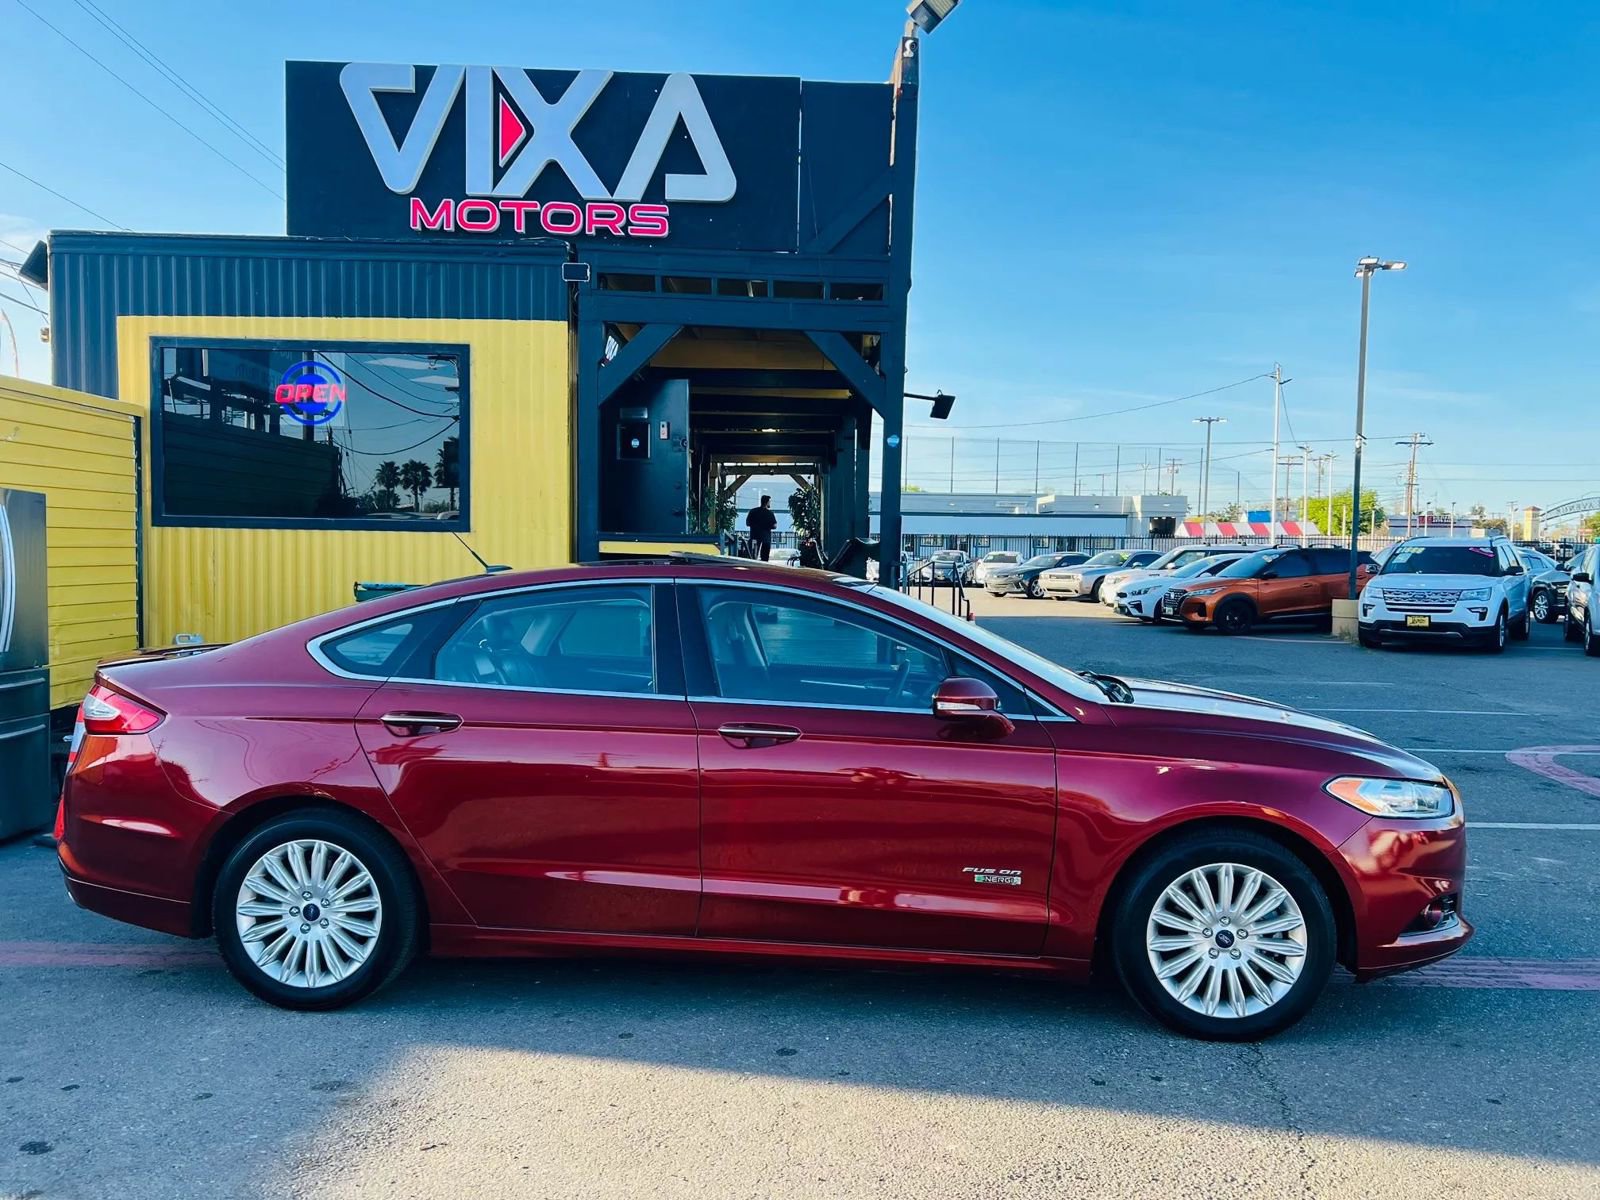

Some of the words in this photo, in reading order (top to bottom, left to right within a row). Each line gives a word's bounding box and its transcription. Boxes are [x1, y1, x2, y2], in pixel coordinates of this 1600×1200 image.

[340, 62, 737, 202] VIXA
[410, 198, 670, 237] MOTORS
[274, 383, 347, 404] OPEN
